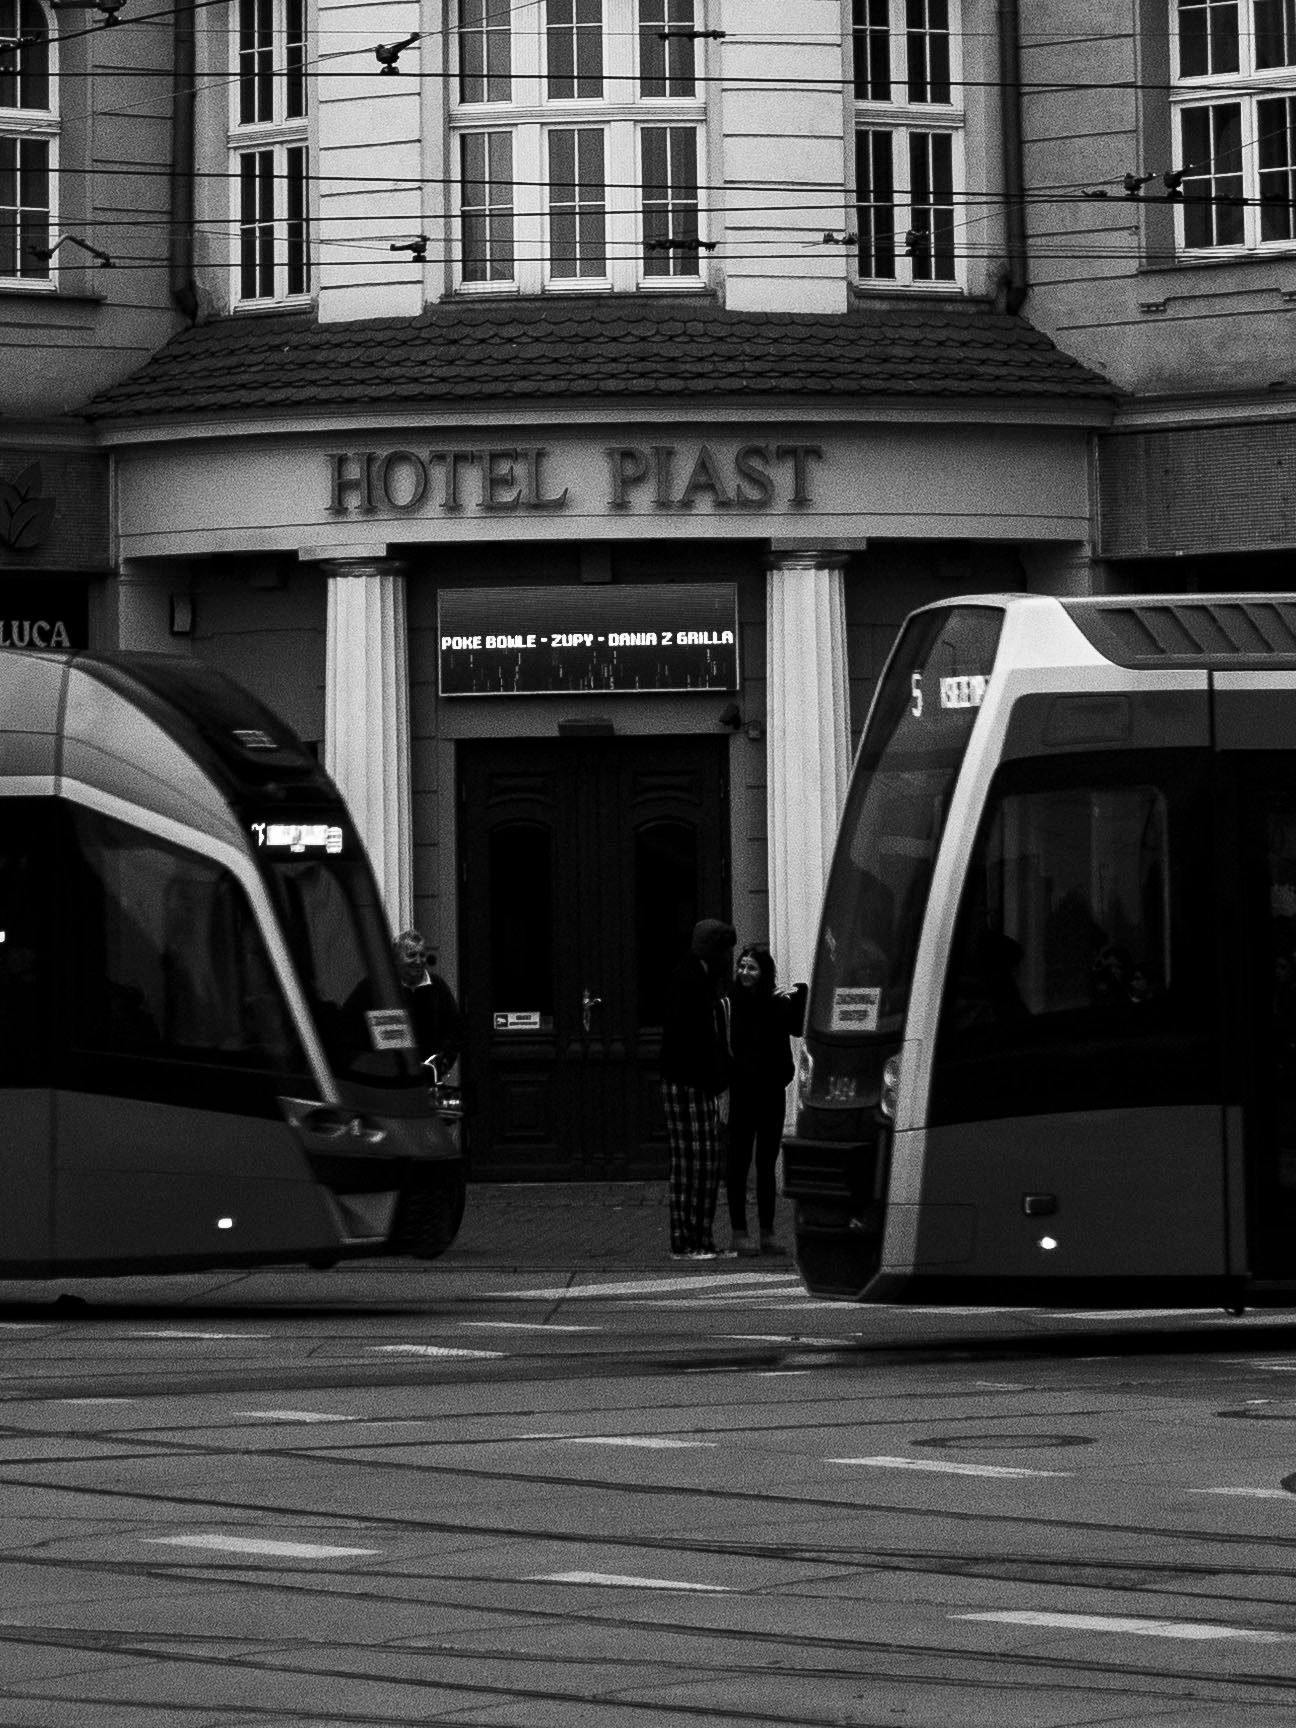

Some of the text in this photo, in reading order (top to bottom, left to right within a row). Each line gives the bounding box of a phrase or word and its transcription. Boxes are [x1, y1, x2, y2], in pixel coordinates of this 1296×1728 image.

[323, 443, 823, 515] HOTEL PIAST
[441, 636, 482, 650] POKE
[550, 633, 594, 647] ZUPY
[608, 632, 658, 647] DANIA
[661, 632, 673, 646] Z
[676, 630, 734, 645] GRILLA
[910, 672, 924, 718] 5
